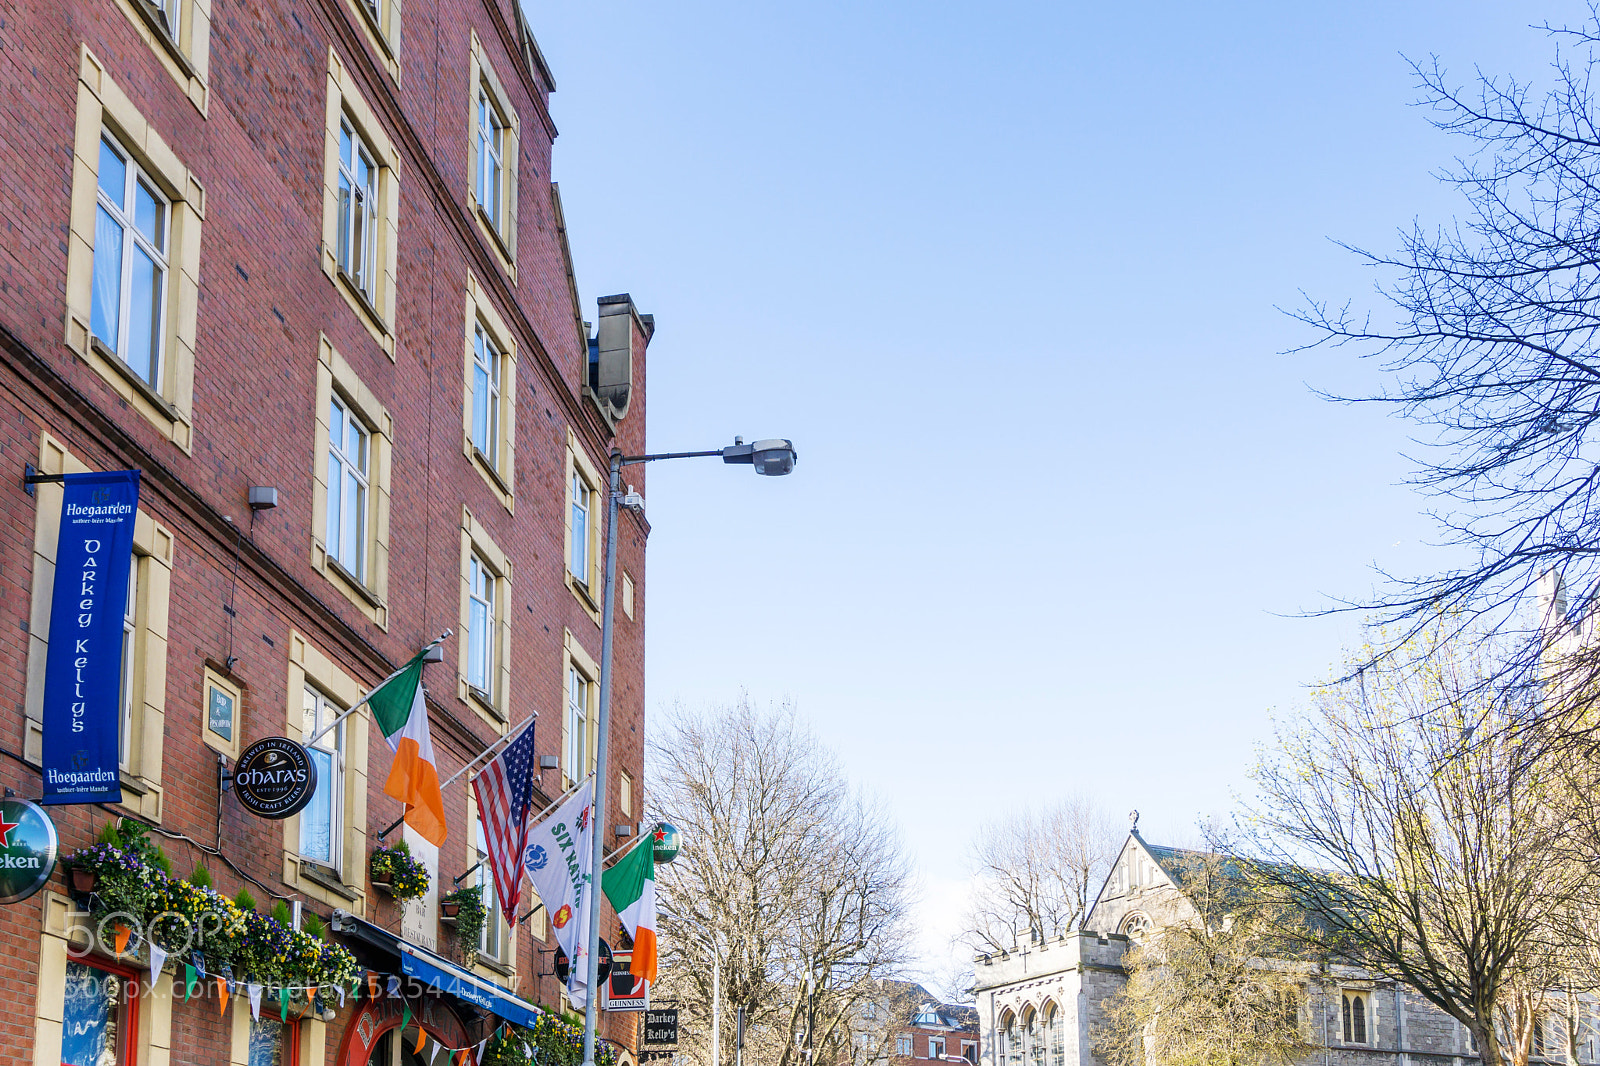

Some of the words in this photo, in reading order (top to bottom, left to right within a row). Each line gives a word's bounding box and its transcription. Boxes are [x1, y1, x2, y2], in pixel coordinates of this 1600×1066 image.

[67, 501, 131, 518] Hoegaarden
[240, 744, 265, 769] BREWED
[279, 742, 304, 767] IRELAND
[48, 767, 115, 786] Hoegaarden
[241, 789, 259, 807] IRISH
[260, 801, 282, 809] CRAFT
[284, 786, 302, 805] BEERS
[551, 822, 574, 853] SIX
[415, 904, 426, 918] BAR
[403, 926, 436, 950] RESTAURANT
[647, 1013, 676, 1024] Darkey
[647, 1028, 675, 1041] Kelly's
